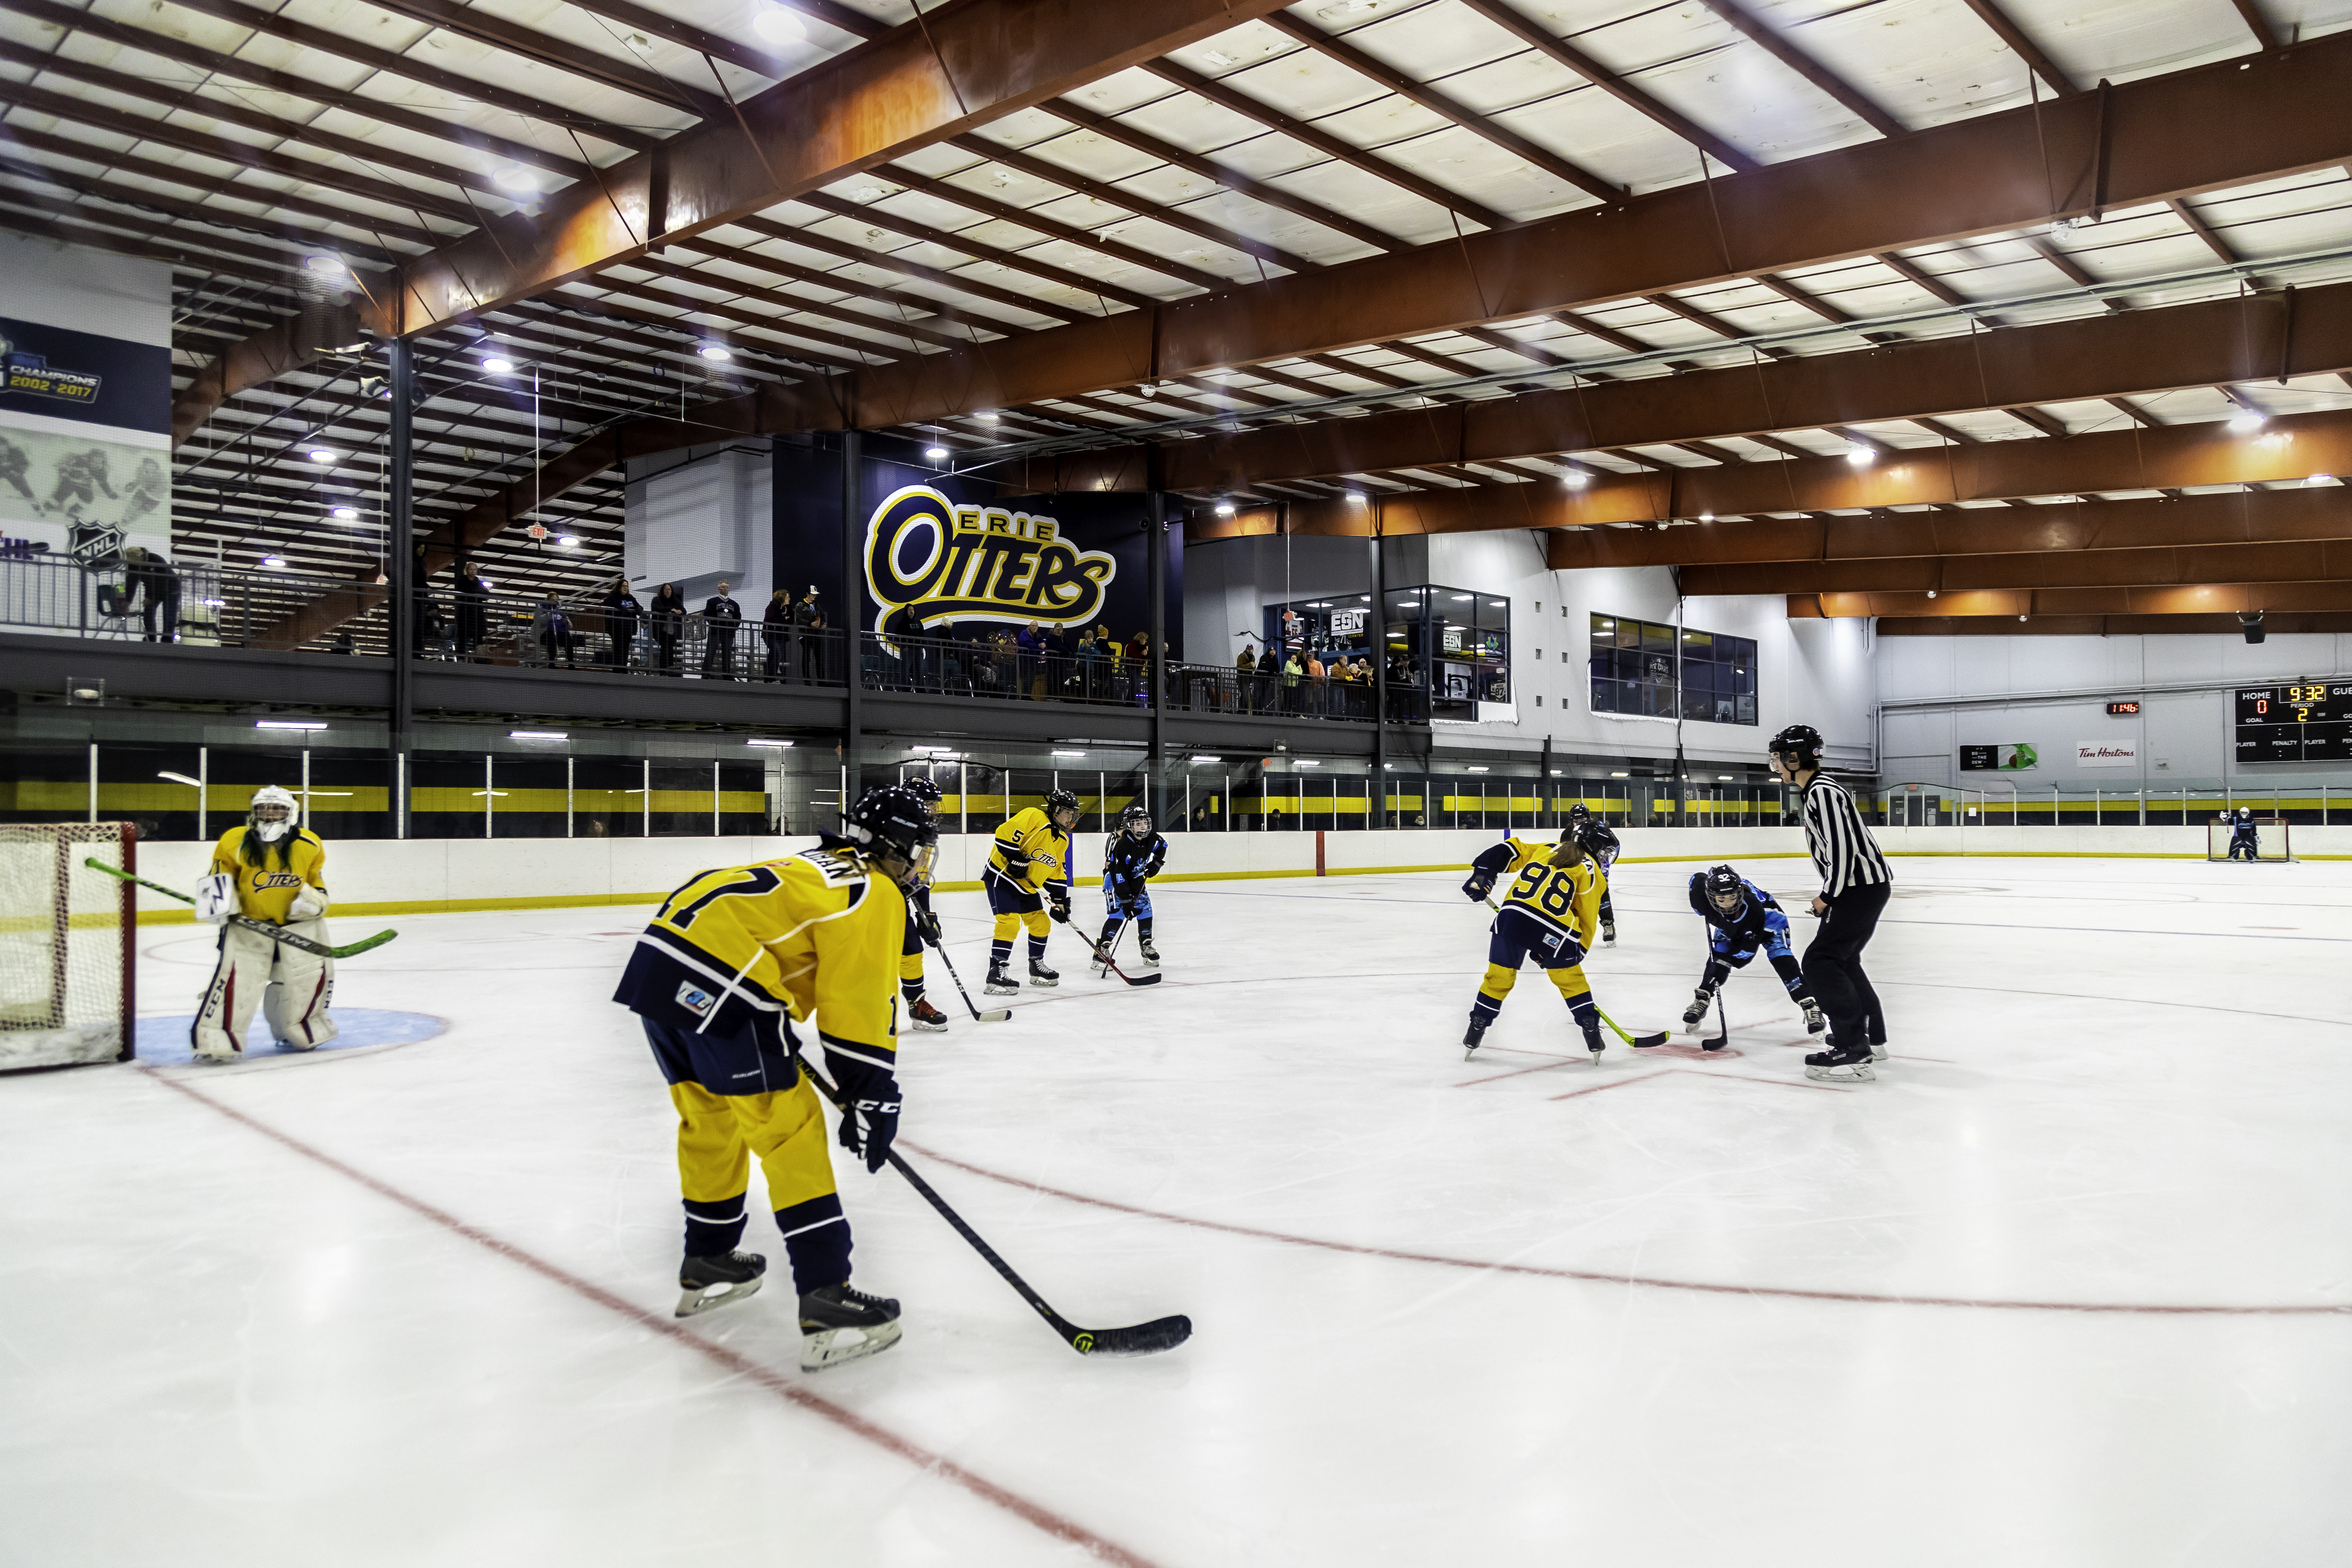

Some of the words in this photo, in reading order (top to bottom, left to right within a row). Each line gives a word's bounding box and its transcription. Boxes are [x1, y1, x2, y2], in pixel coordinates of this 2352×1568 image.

[10, 365, 98, 386] CHAMPIONS
[533, 527, 545, 537] EXIT
[960, 514, 1054, 542] ERIE
[80, 536, 115, 557] NHL
[867, 489, 1113, 624] OTTERS
[1332, 613, 1363, 631] ESN
[1443, 634, 1461, 648] ESN
[1495, 688, 1504, 696] 87
[2290, 686, 2324, 701] 9:32
[2257, 700, 2267, 714] 0
[2298, 708, 2308, 722] 2
[2079, 748, 2096, 758] Tim
[2097, 747, 2135, 757] Hortons
[1012, 829, 1025, 843] 5
[1512, 861, 1575, 916] 98
[655, 867, 782, 930] 17
[949, 968, 965, 993] CCM
[205, 978, 226, 1019] CCM
